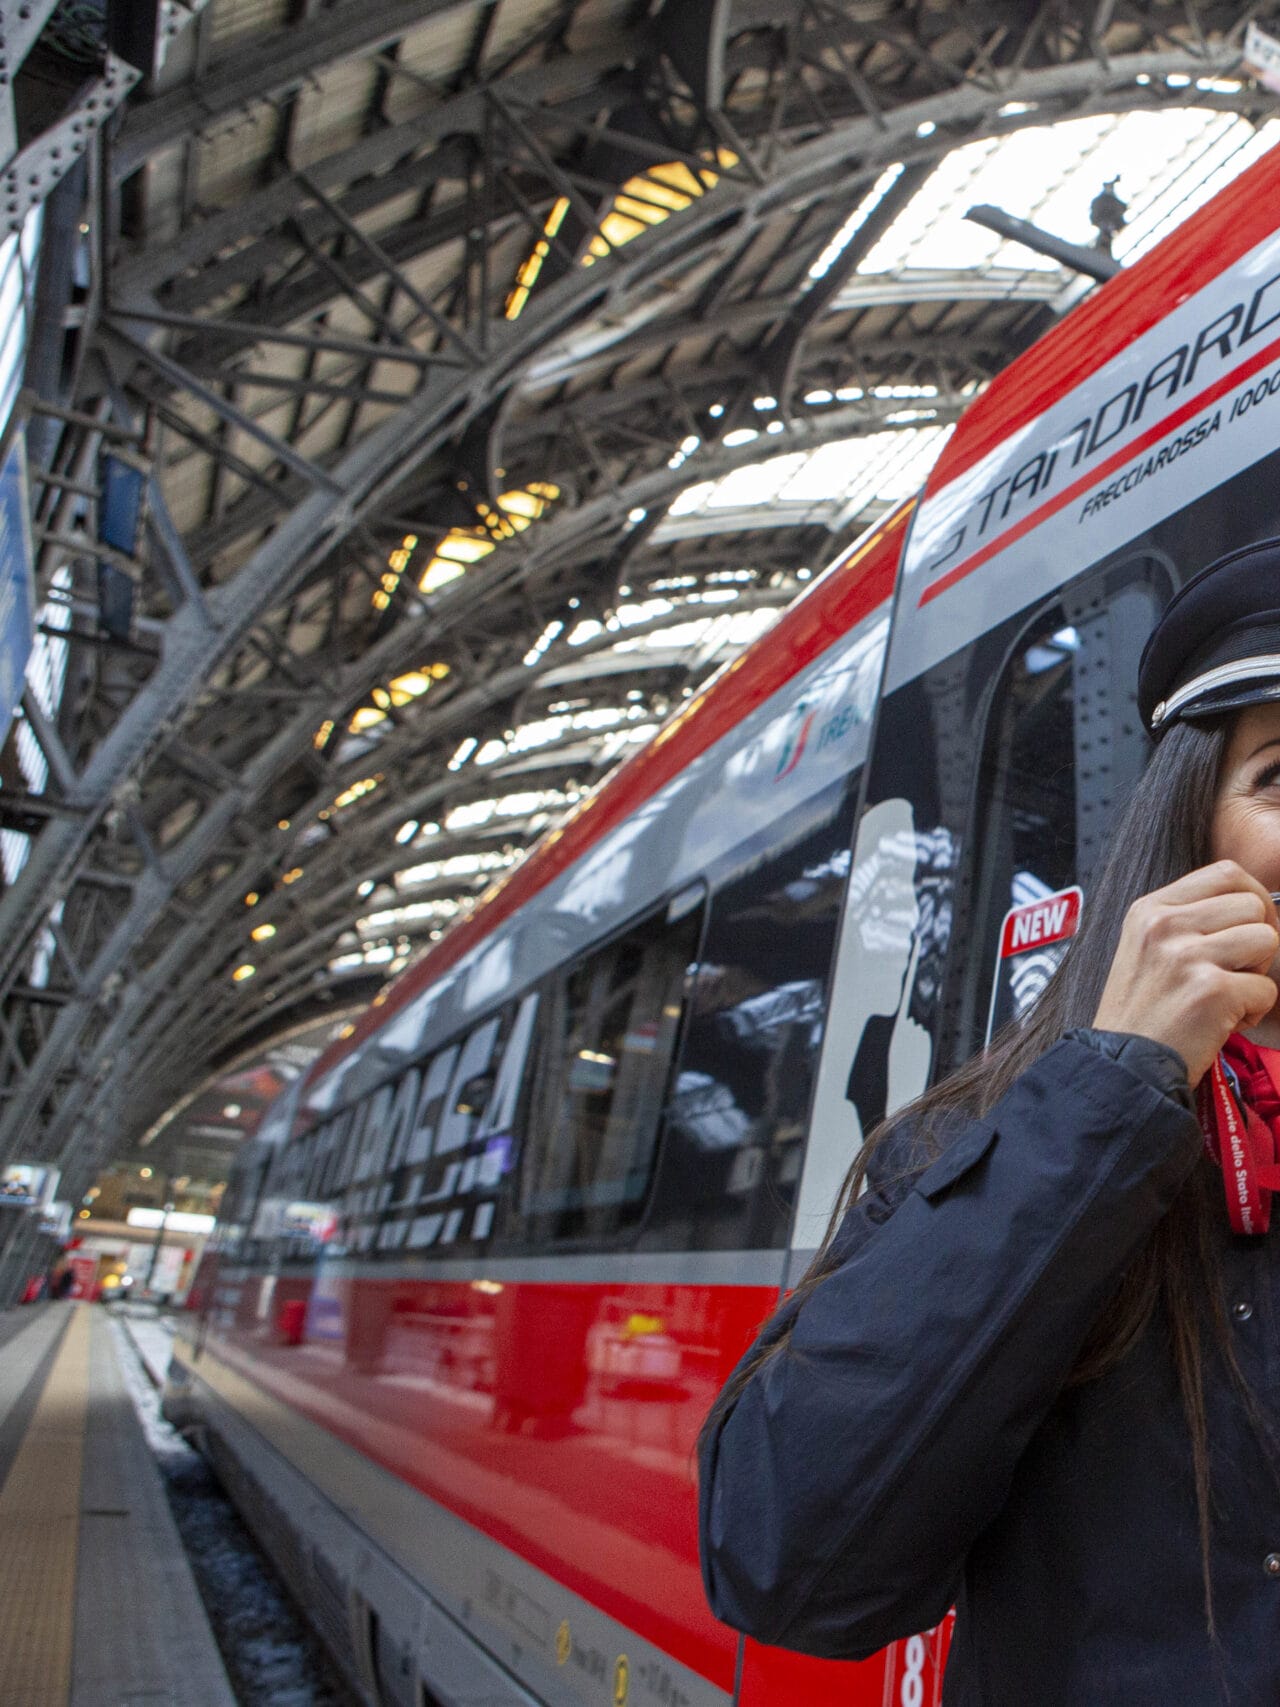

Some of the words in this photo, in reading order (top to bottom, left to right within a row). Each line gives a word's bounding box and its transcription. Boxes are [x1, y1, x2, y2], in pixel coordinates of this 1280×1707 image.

[1079, 410, 1223, 524] FRECCIAROSSA
[1011, 899, 1069, 948] NEW
[1230, 1135, 1243, 1167] dello
[1236, 1169, 1248, 1204] Stato
